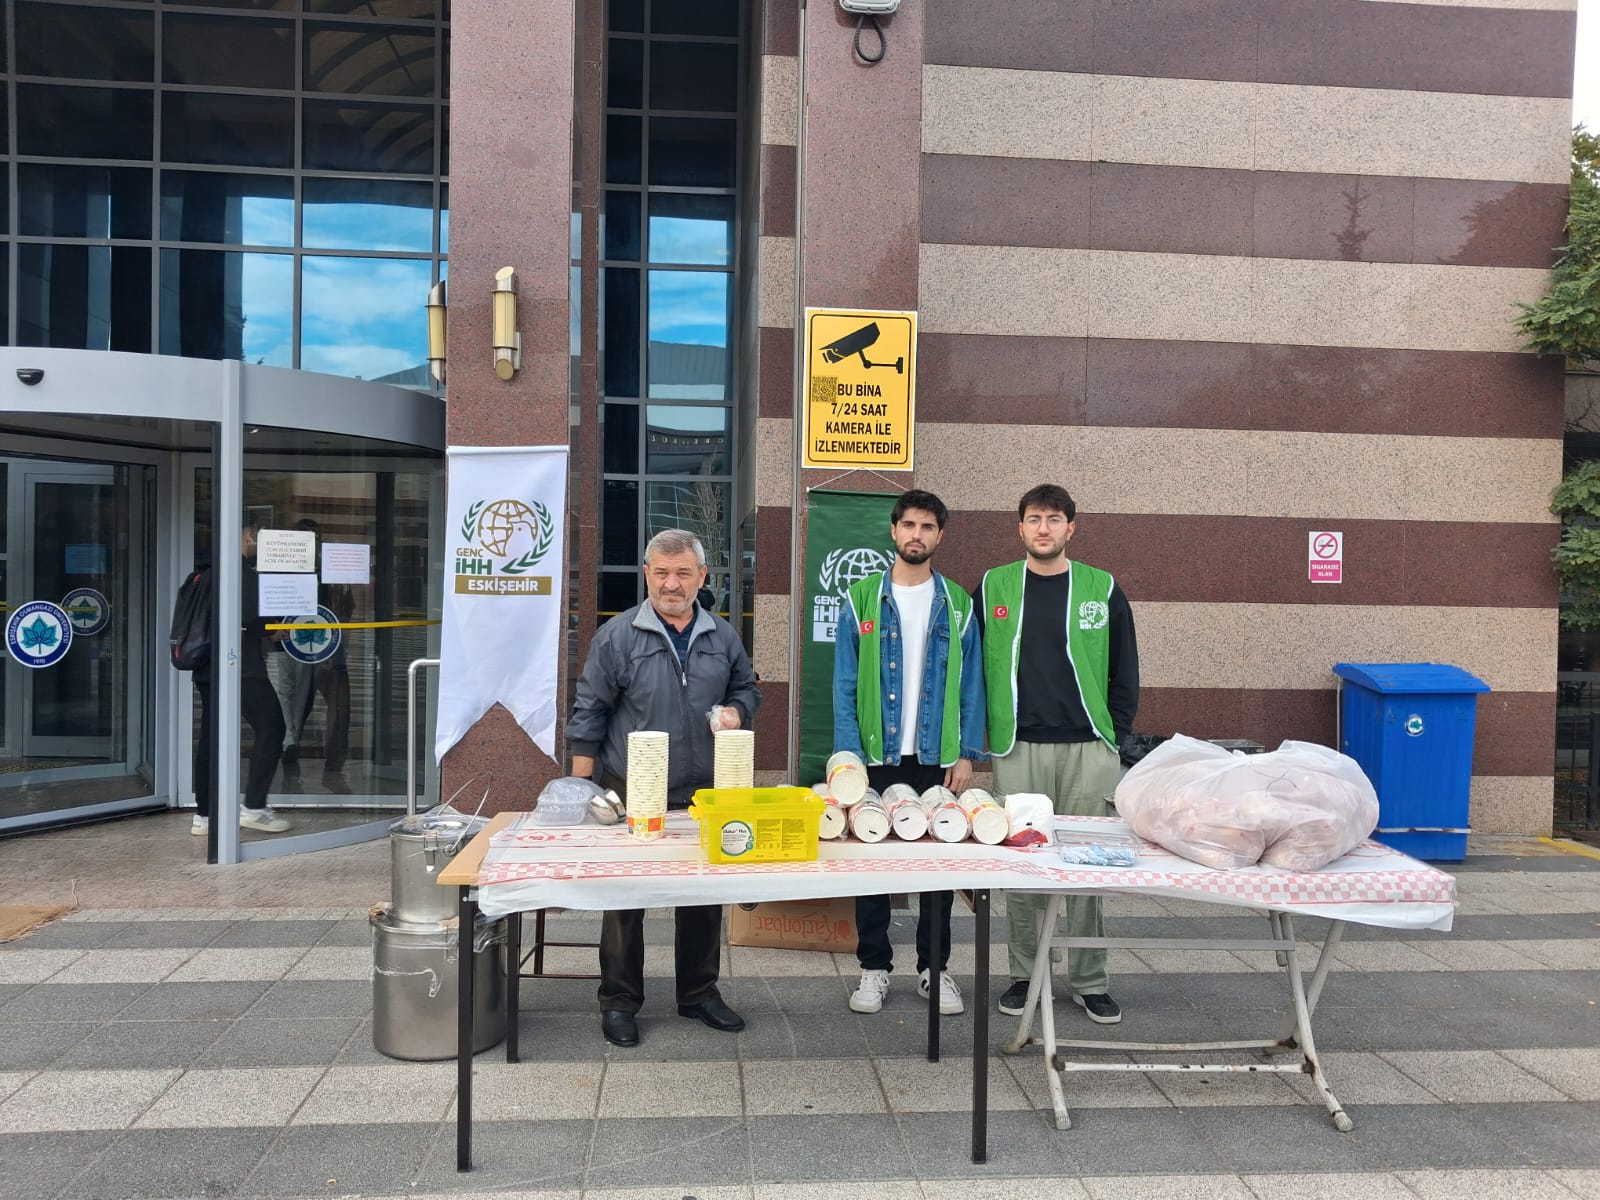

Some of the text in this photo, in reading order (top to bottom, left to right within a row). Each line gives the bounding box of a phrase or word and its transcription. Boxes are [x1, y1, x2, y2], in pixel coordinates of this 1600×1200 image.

[837, 382, 882, 397] BU BİNA
[831, 403, 887, 417] 7/24 SAAT
[825, 420, 891, 435] KAMERA İLE
[815, 437, 901, 454] İZLENMEKTEDİR
[468, 577, 539, 595] ESKİŞEHİR
